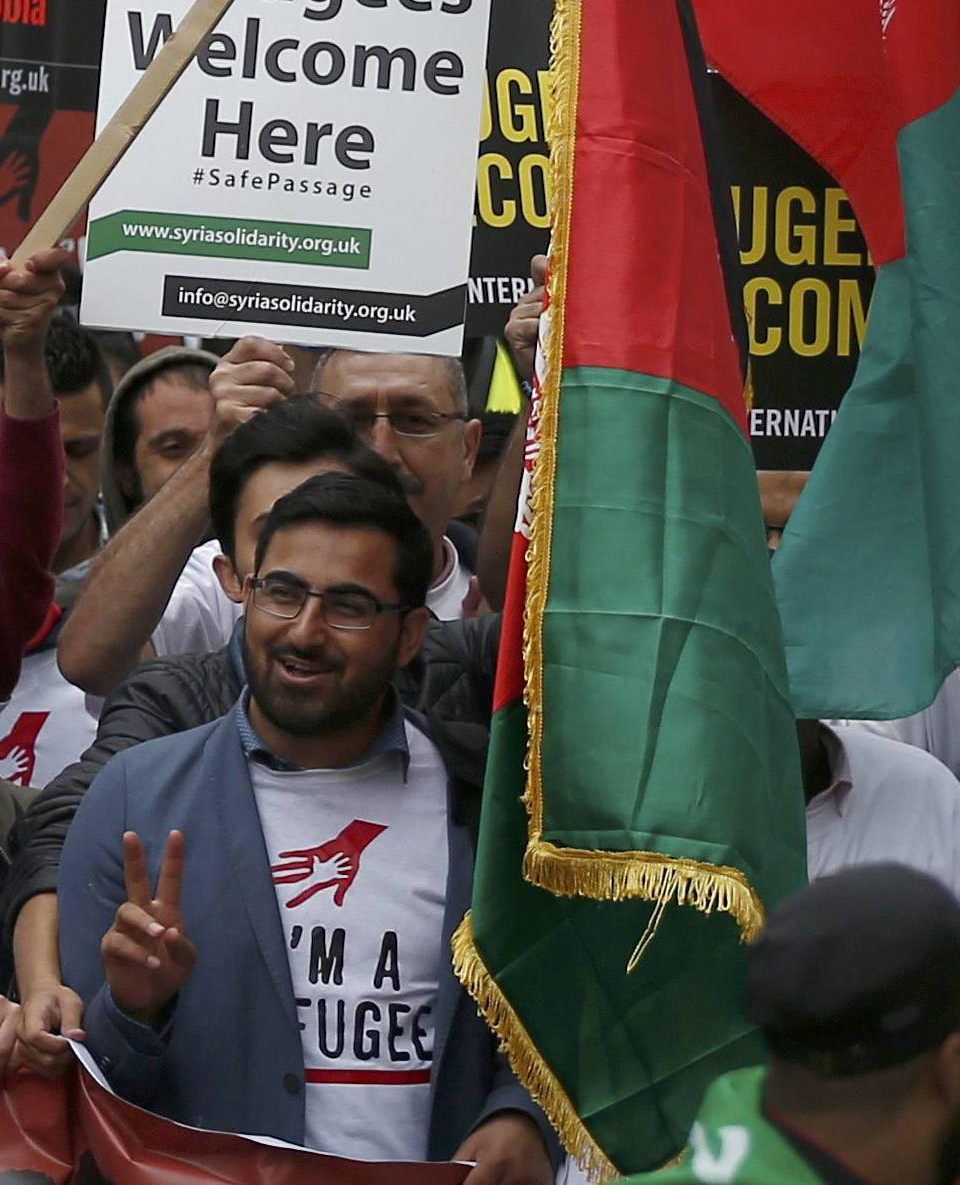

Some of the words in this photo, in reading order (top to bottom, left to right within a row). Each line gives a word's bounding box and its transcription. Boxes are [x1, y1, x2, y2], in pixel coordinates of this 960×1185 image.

[200, 98, 375, 169] Here
[192, 168, 372, 201] #SafePassage
[122, 222, 361, 255] www.syriasolidarity.org.uk
[731, 186, 873, 265] UGE
[178, 287, 416, 323] info@syriasolidarity.org.uk
[750, 409, 837, 436] ERNAT
[373, 931, 401, 992] A
